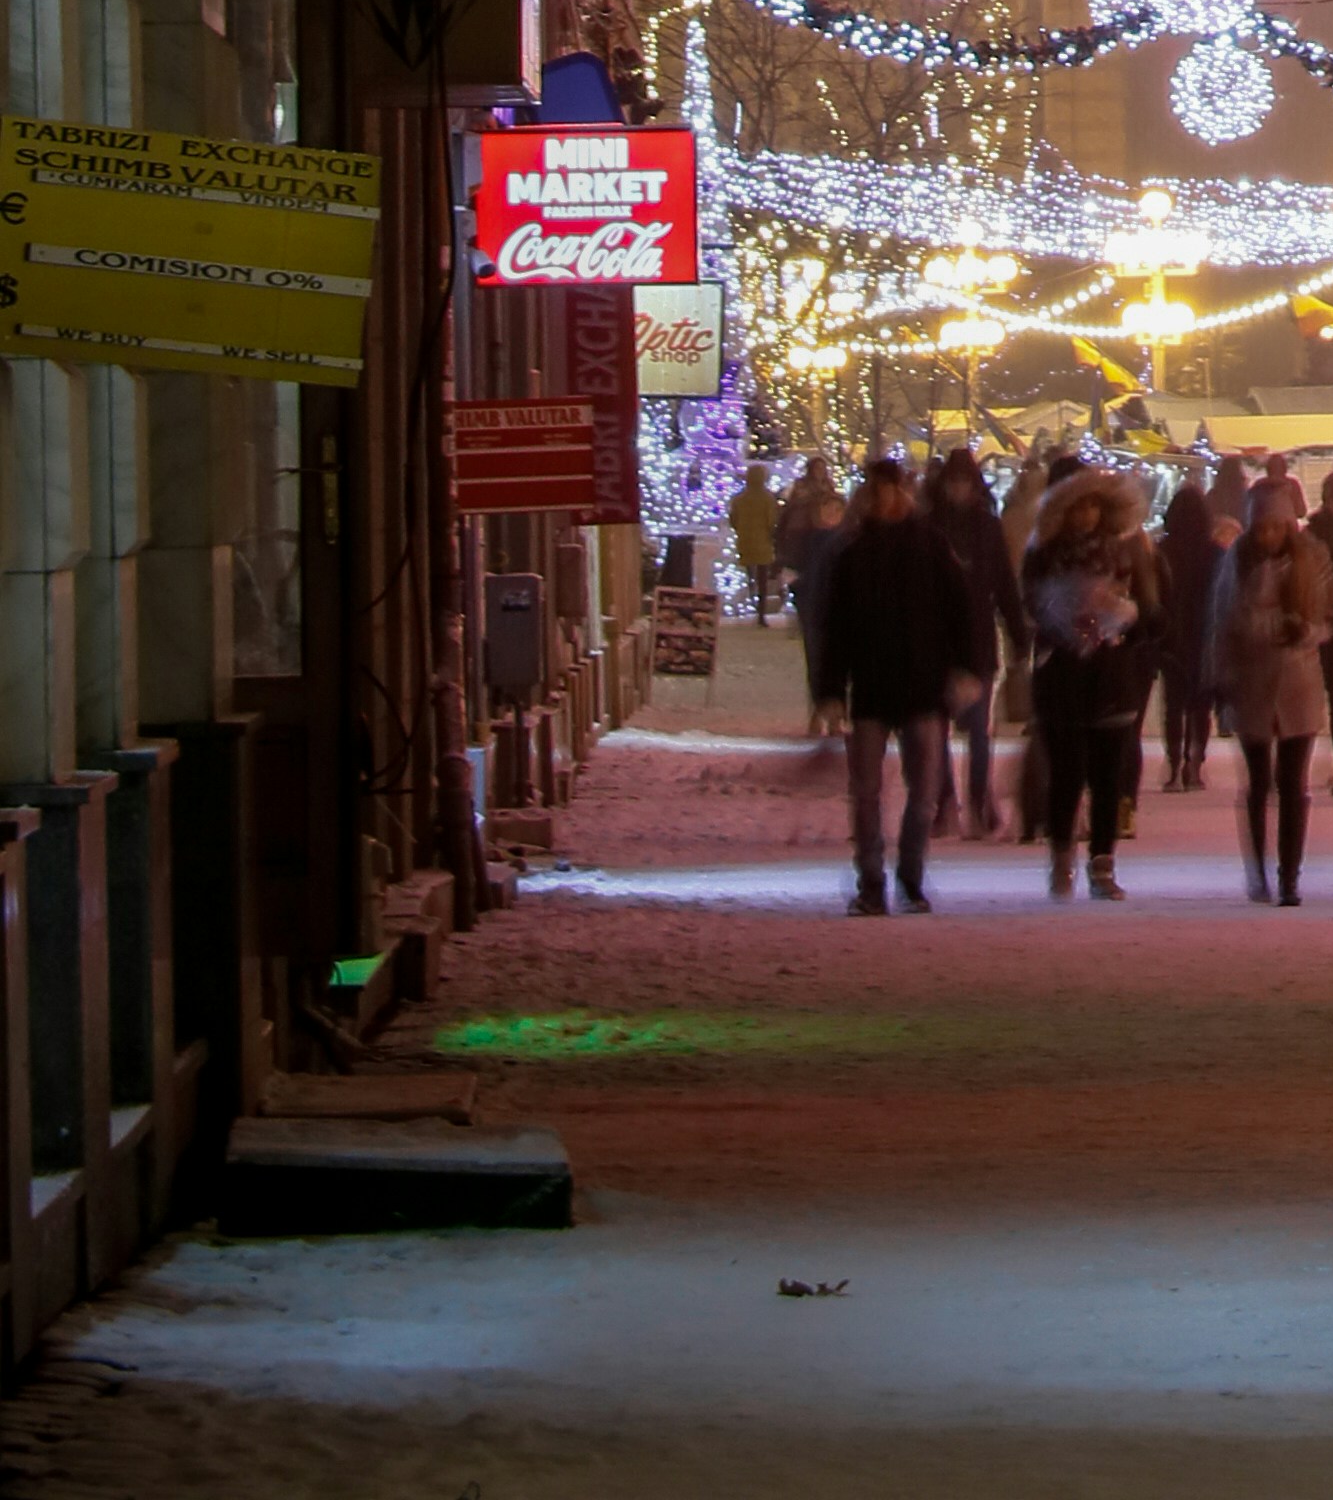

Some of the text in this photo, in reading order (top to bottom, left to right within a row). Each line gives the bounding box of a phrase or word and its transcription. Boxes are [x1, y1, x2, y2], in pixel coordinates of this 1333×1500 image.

[13, 121, 374, 179] TABRIZI EXCHANGE
[544, 138, 629, 170] MINI
[15, 148, 358, 202] SCHIMB VALUTAR
[507, 170, 668, 205] MARKET
[74, 249, 252, 283] COMISION
[498, 221, 673, 280] Coca-Cola
[56, 326, 149, 347] WE BUY
[220, 344, 322, 366] WE SELL
[650, 348, 701, 366] shop
[456, 407, 581, 428] HIMB VALUTAR
